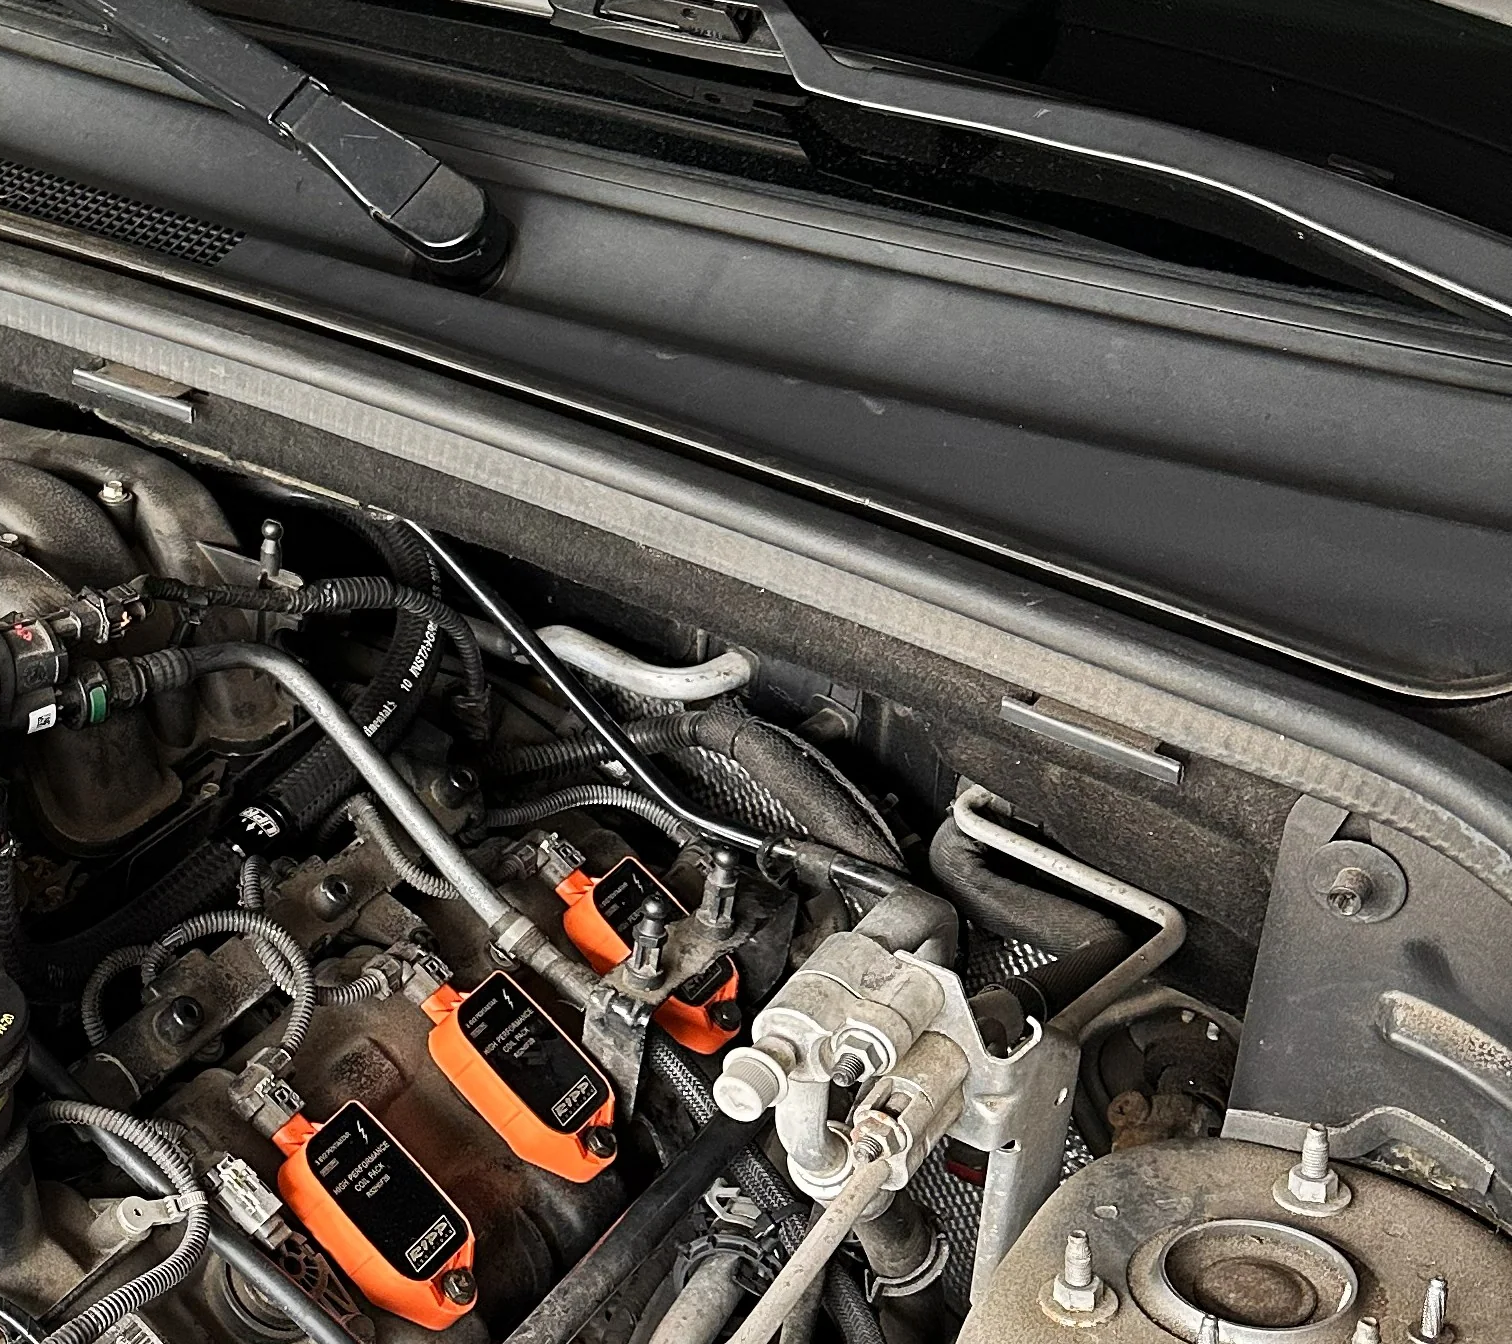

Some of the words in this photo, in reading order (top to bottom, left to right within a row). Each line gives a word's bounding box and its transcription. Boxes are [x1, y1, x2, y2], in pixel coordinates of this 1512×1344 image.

[399, 677, 414, 692] 10
[483, 1040, 498, 1055] HIGH
[495, 1006, 534, 1043] PERFORMANCE
[501, 1038, 517, 1053] COIL
[513, 1026, 530, 1041] PACK
[553, 1080, 591, 1116] RIPP
[332, 1178, 349, 1195] HIGH
[346, 1140, 390, 1181] PERFORMANCE
[353, 1176, 370, 1192] COIL
[367, 1161, 385, 1179] PACK
[407, 1220, 447, 1261] RIPP
